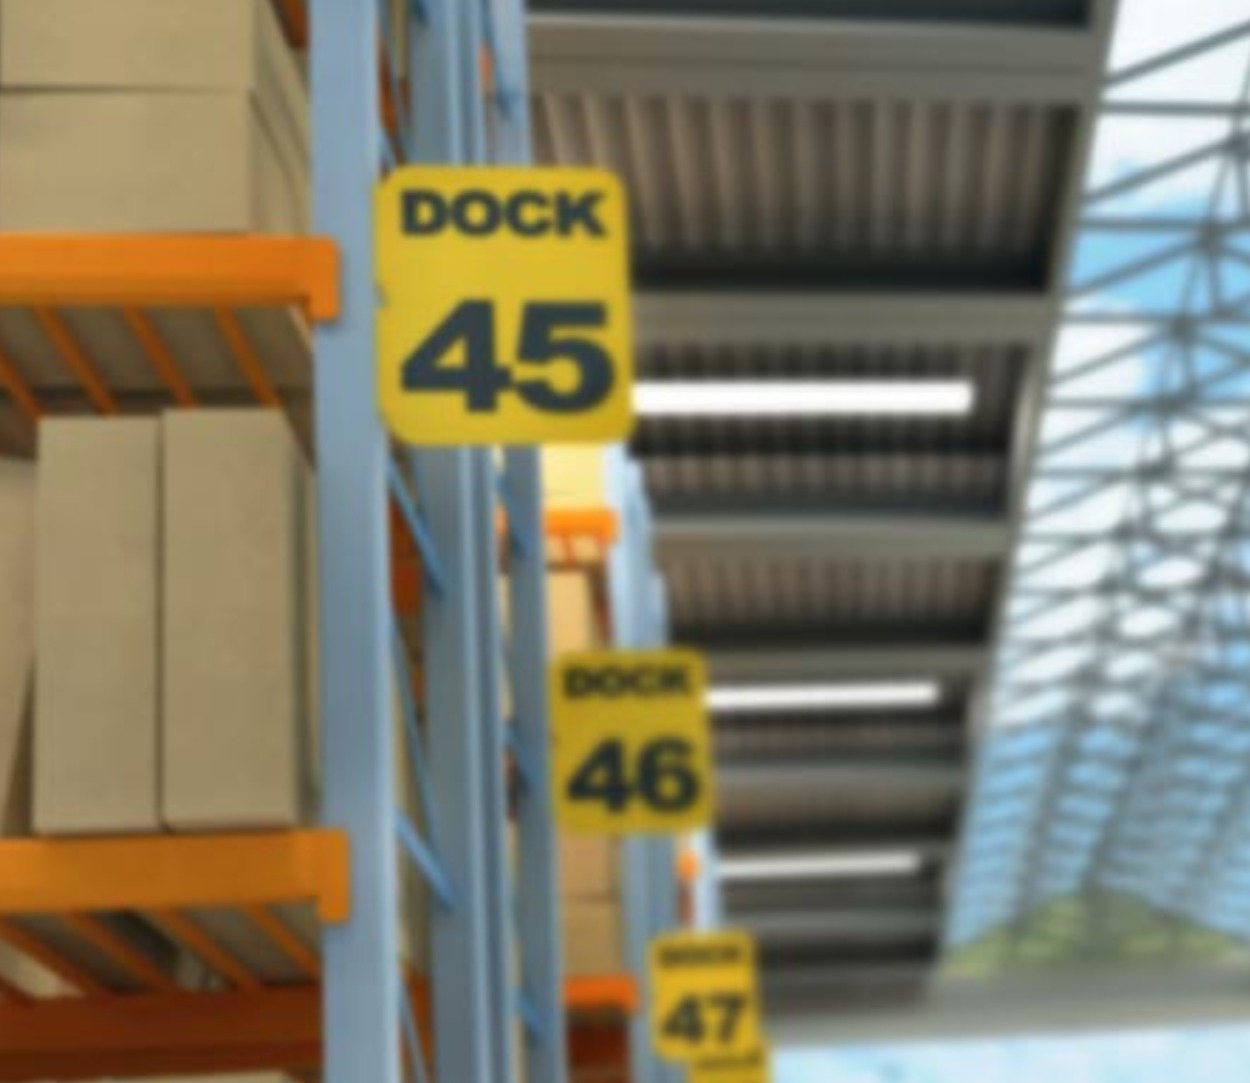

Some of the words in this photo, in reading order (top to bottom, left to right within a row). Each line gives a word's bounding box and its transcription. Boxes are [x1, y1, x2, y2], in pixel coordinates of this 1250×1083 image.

[401, 187, 607, 238] DOCK
[400, 298, 616, 415] 45
[566, 735, 700, 816] 46
[663, 992, 746, 1044] 47
